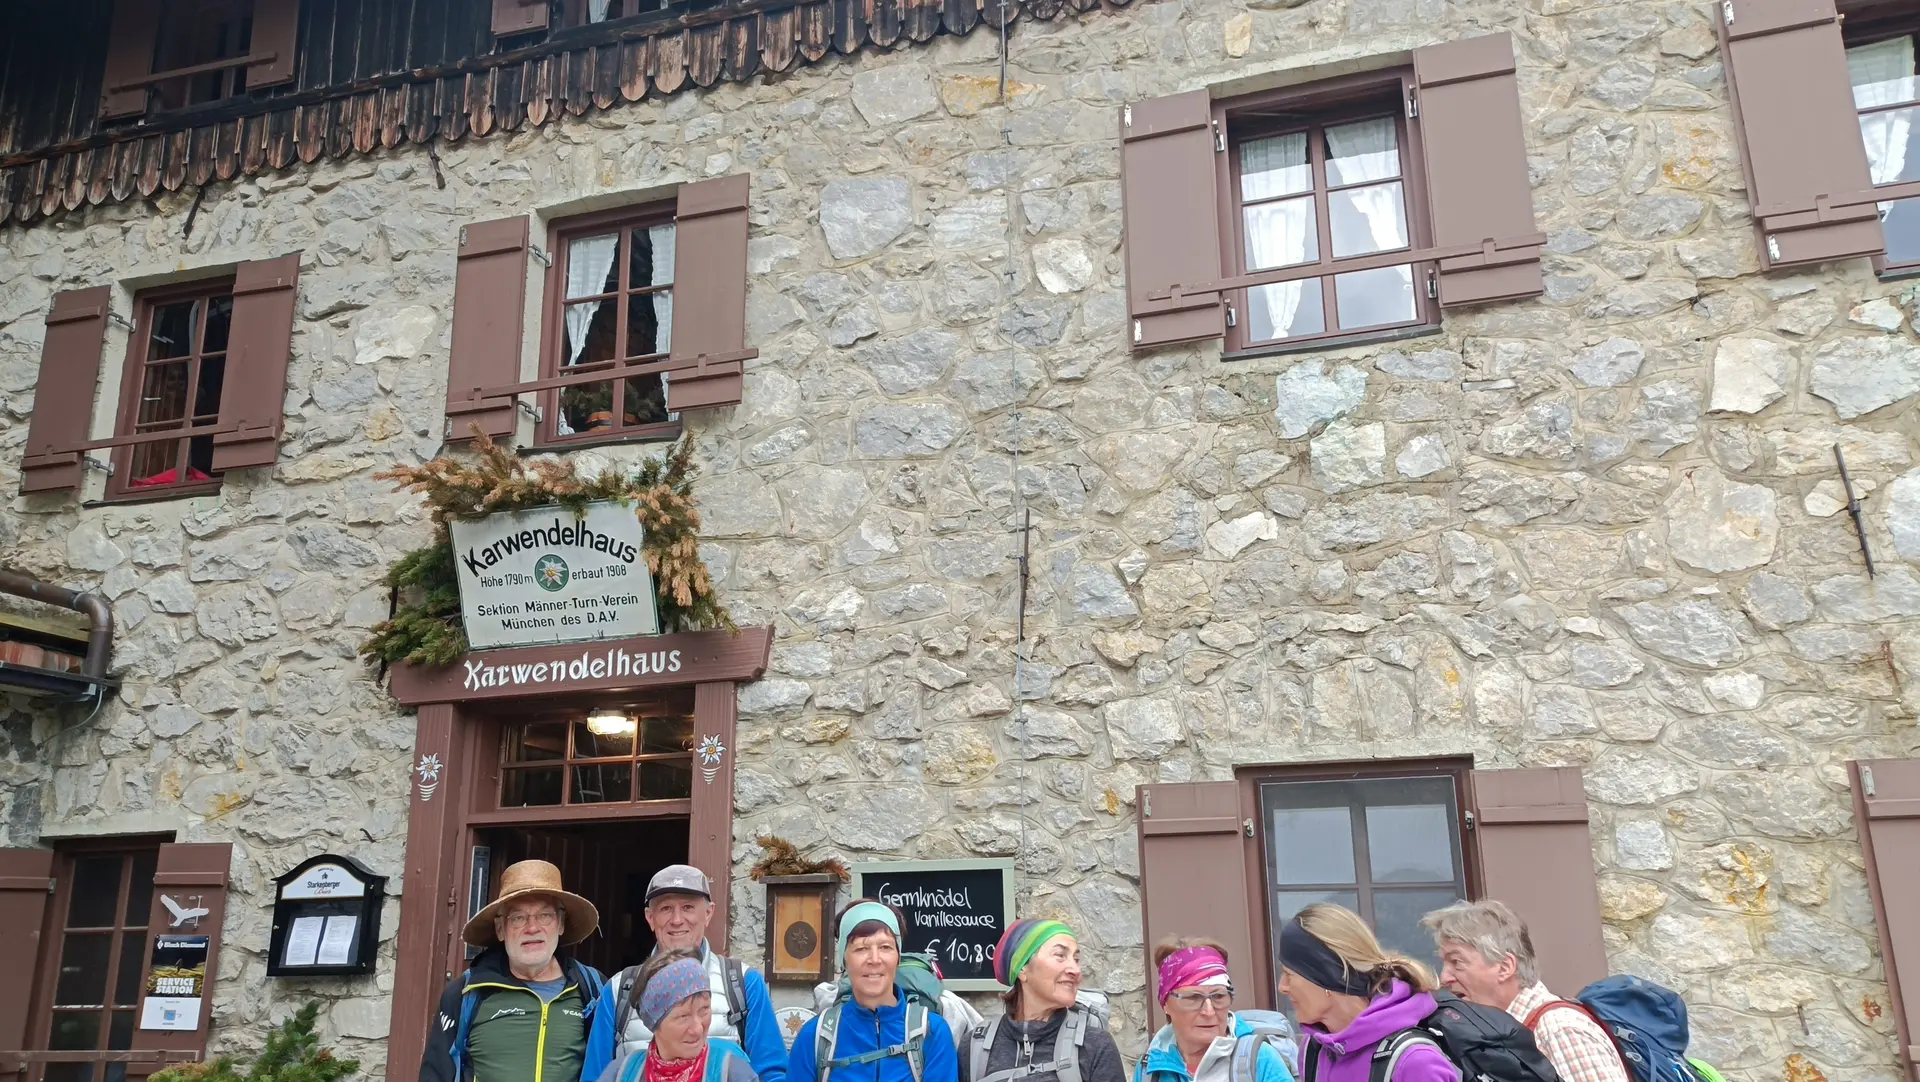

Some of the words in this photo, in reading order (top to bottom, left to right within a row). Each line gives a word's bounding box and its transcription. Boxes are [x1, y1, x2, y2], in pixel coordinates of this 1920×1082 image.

[460, 517, 637, 577] Karwendelhaus
[480, 576, 503, 588] Höhe
[572, 567, 604, 580] erbaut
[606, 565, 627, 577] 1908
[477, 603, 520, 617] Sektion
[525, 592, 639, 613] Männer-Turn-Verein
[501, 613, 555, 631] München
[560, 611, 581, 626] des
[587, 610, 619, 624] D.A.V.
[463, 647, 682, 692] Karwendelhaus
[878, 882, 972, 909] Germknödel
[914, 910, 997, 929] Vanillesauce
[924, 938, 941, 961] €
[946, 938, 996, 964] 10,80
[155, 985, 194, 995] STATION
[156, 977, 195, 986] SERVICE
